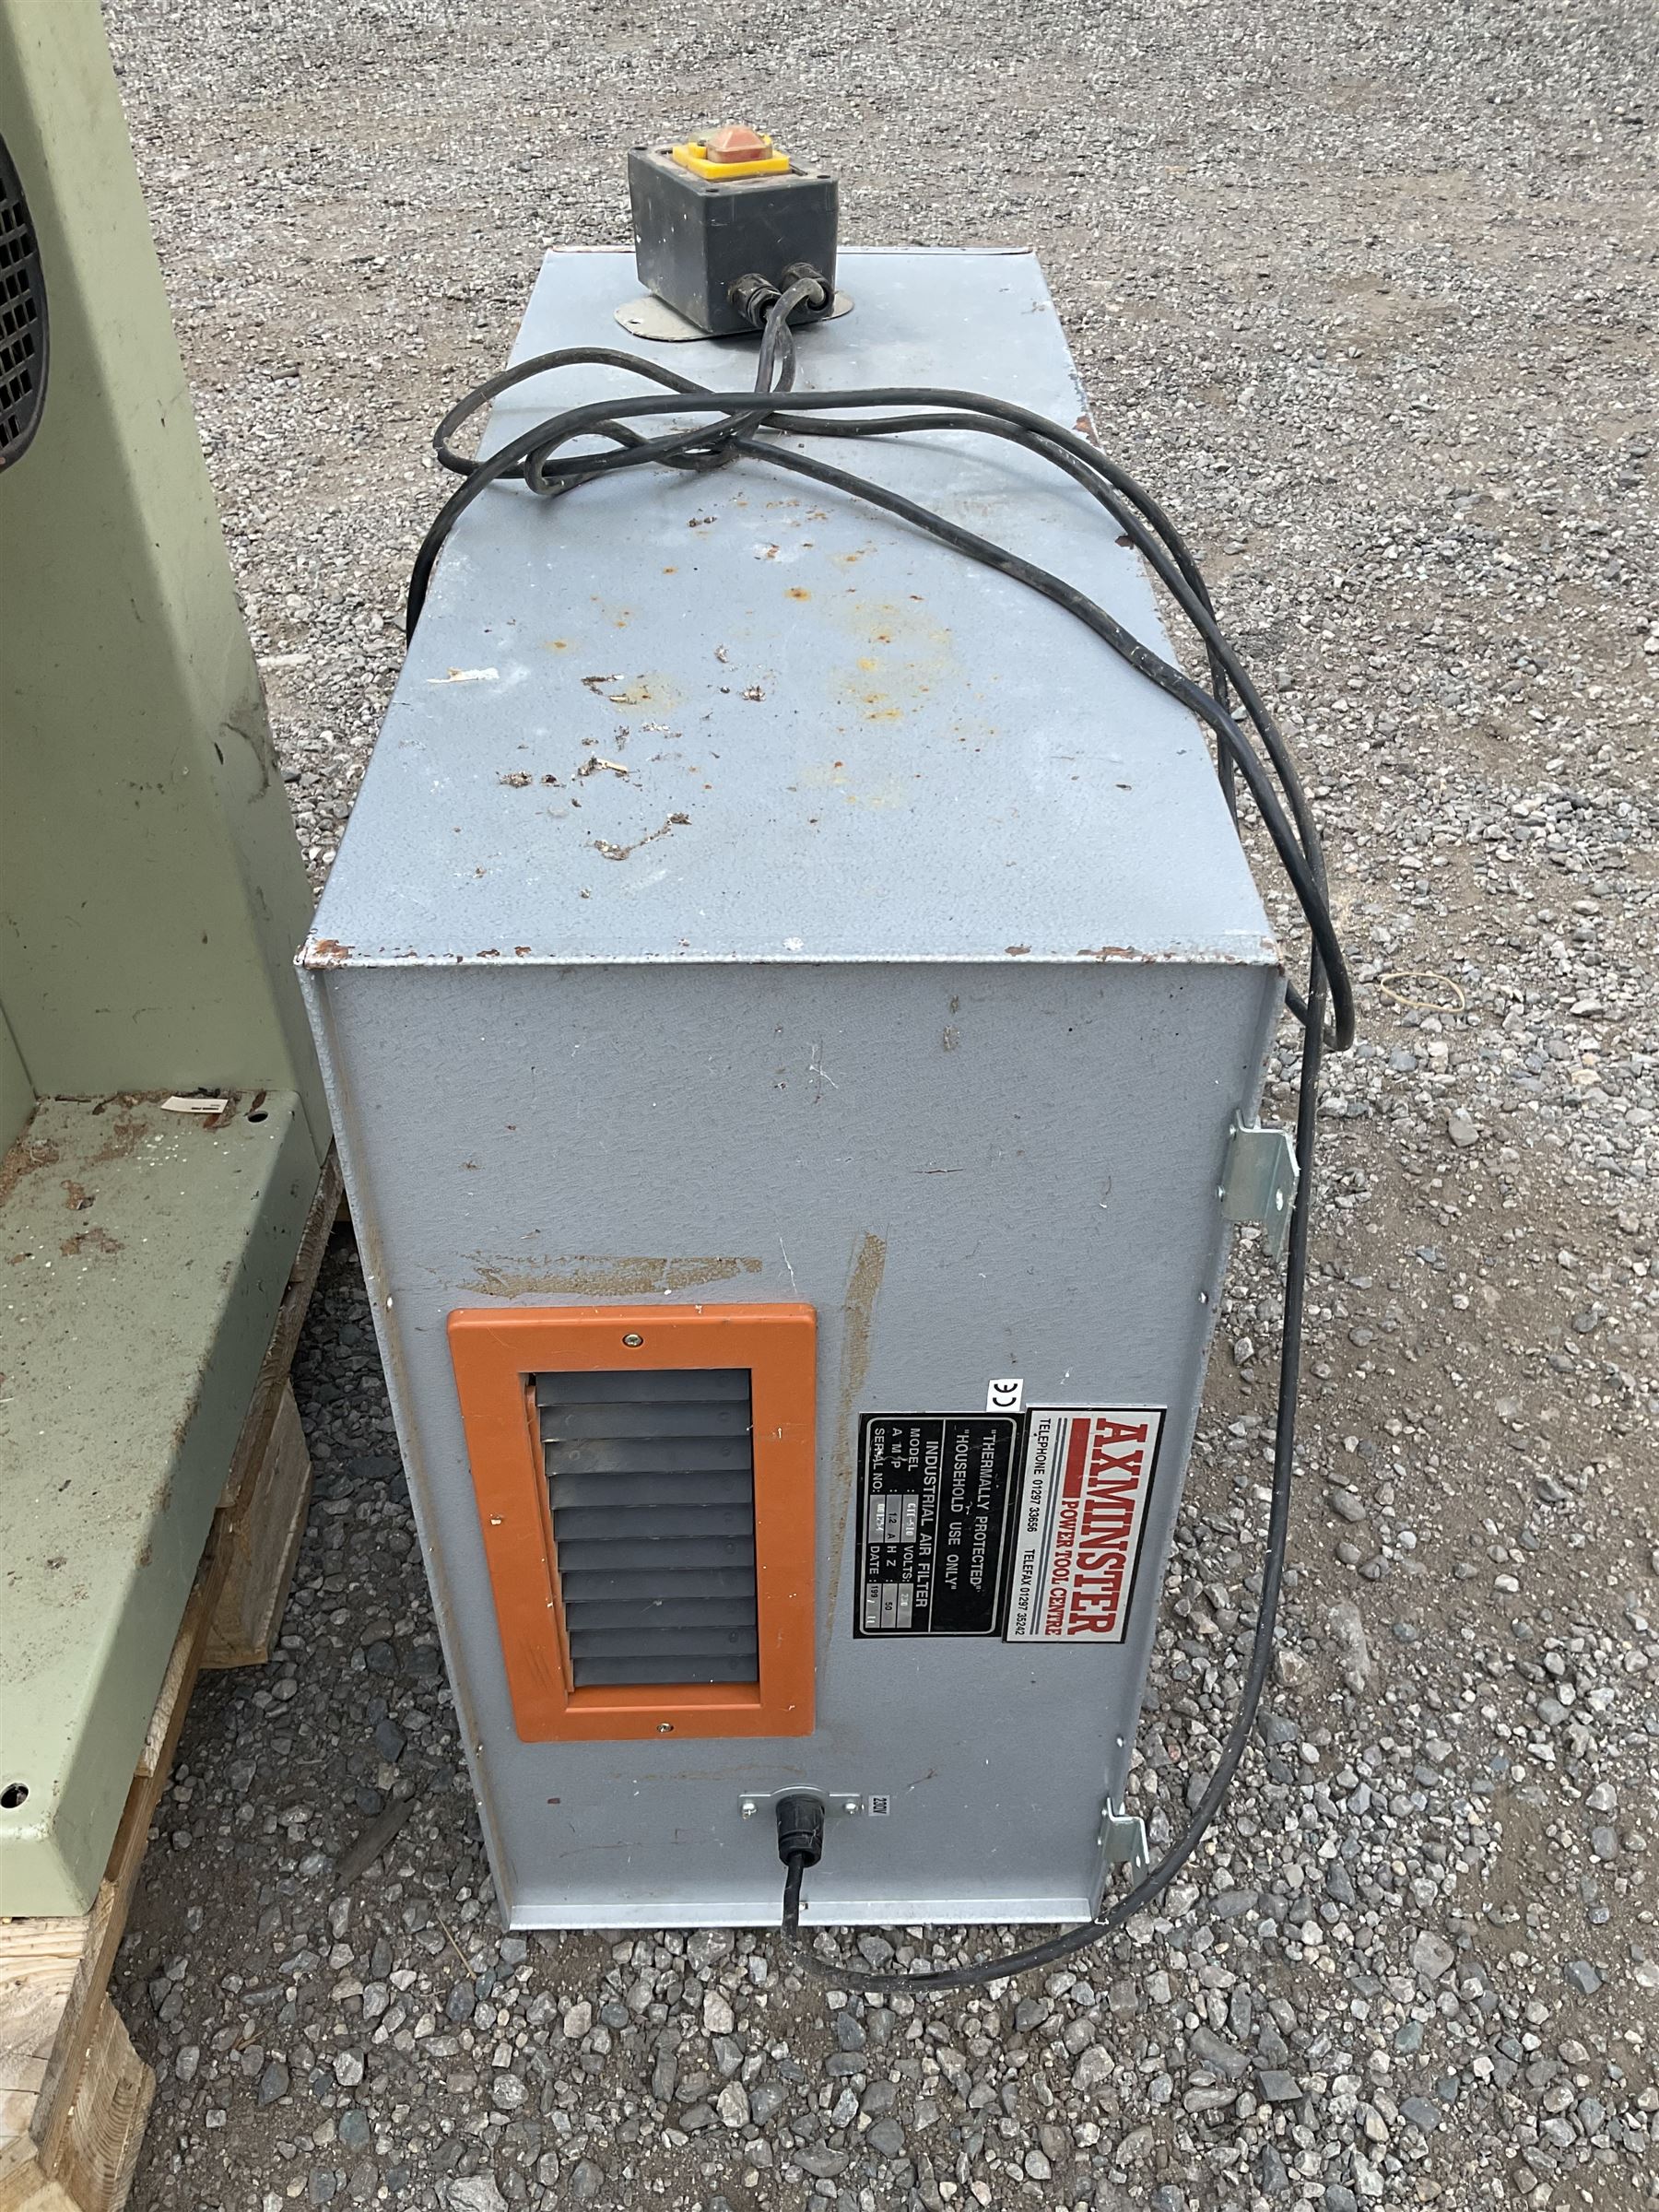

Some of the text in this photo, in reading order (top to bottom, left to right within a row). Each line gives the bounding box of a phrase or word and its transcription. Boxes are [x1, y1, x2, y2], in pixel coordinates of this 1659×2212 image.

[908, 1428, 921, 1472] MODEL
[977, 1429, 996, 1511] "THERMALLY
[869, 1546, 880, 1575] DATE
[888, 1512, 898, 1524] 1.2
[915, 1441, 939, 1607] INDUSTRIAL AIR FILTER
[945, 1429, 970, 1590] "HOUSEHOLD USE ONLY"
[1015, 1418, 1051, 1636] TELEPHONE 01297 33656 TELEFAX 01297 35242
[1067, 1418, 1148, 1635] AXMINSTER
[885, 1601, 892, 1611] 50
[1044, 1500, 1079, 1635] POWER TOOL CENTRE
